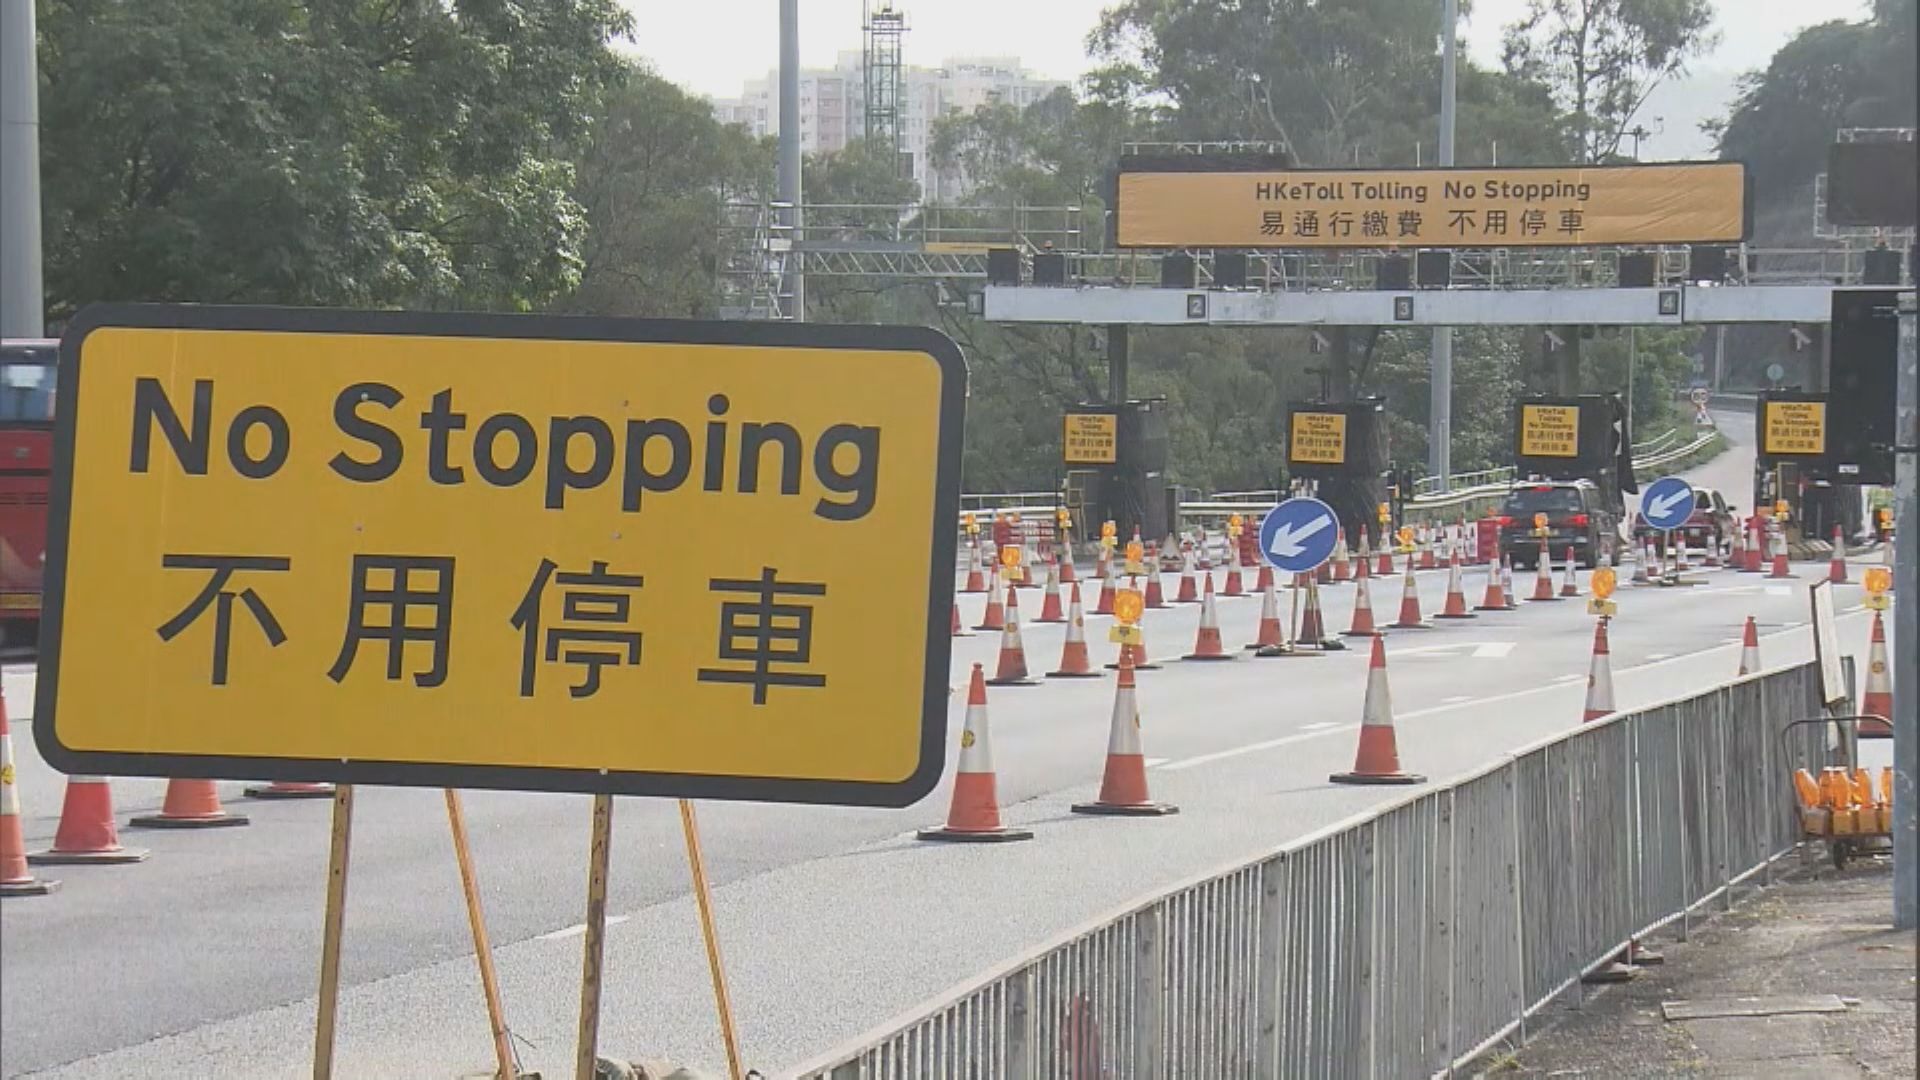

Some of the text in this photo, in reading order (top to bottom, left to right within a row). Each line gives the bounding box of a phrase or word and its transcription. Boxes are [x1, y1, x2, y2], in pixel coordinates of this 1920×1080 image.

[1256, 179, 1591, 204] HKeToll Tolling No Stopping
[1259, 208, 1585, 238] 易通行繳費 不用停車
[1192, 299, 1203, 313] 2
[1663, 294, 1674, 310] 4
[130, 378, 881, 521] No Stopping
[156, 553, 827, 705] 不用停車
